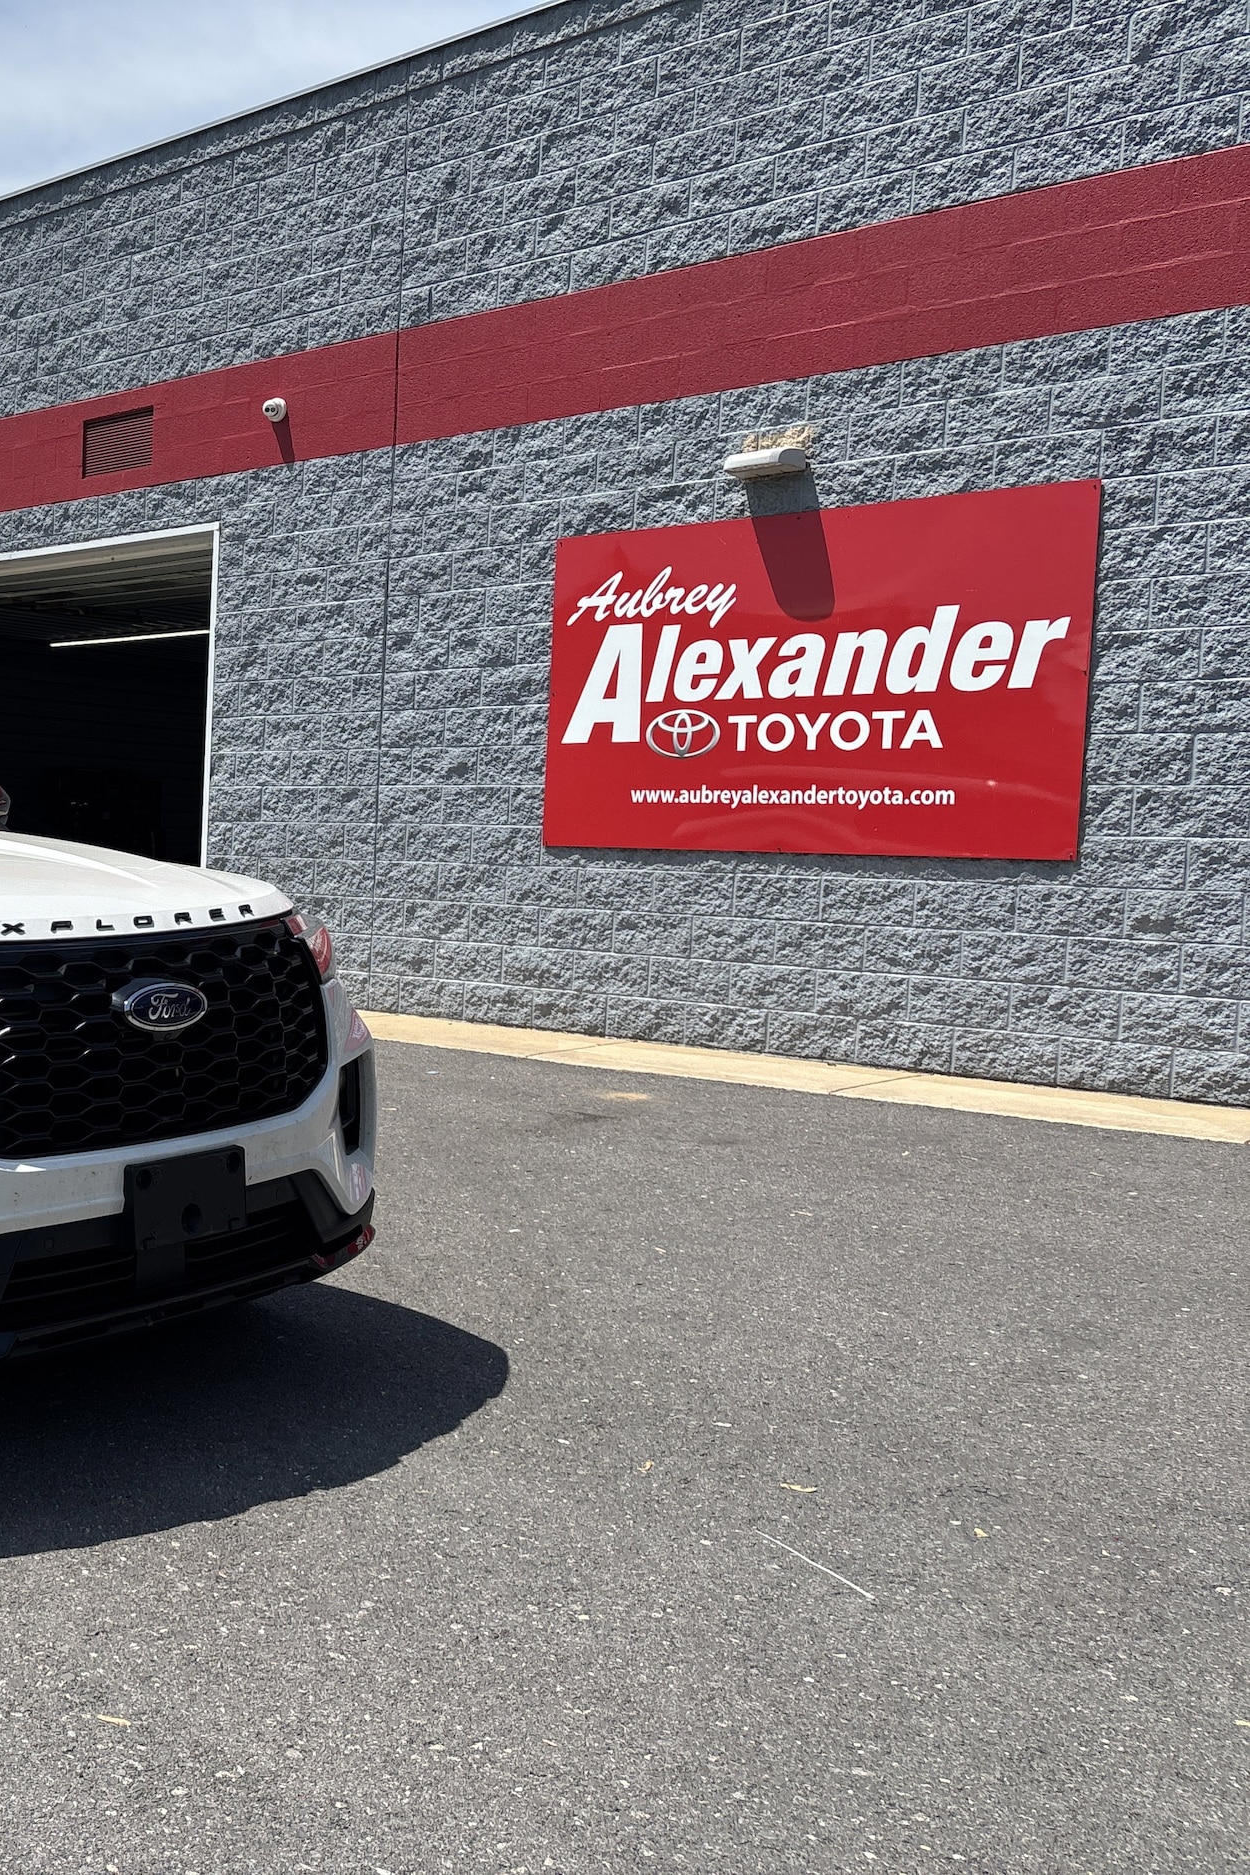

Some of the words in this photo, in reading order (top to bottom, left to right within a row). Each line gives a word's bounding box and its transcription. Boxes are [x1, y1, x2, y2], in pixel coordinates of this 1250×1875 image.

[566, 565, 737, 628] Aubrey
[561, 604, 1072, 744] Alexander
[727, 708, 944, 752] TOYOTA
[630, 784, 955, 810] www.aubreyalexandertoyota.com
[148, 992, 191, 1020] Ford
